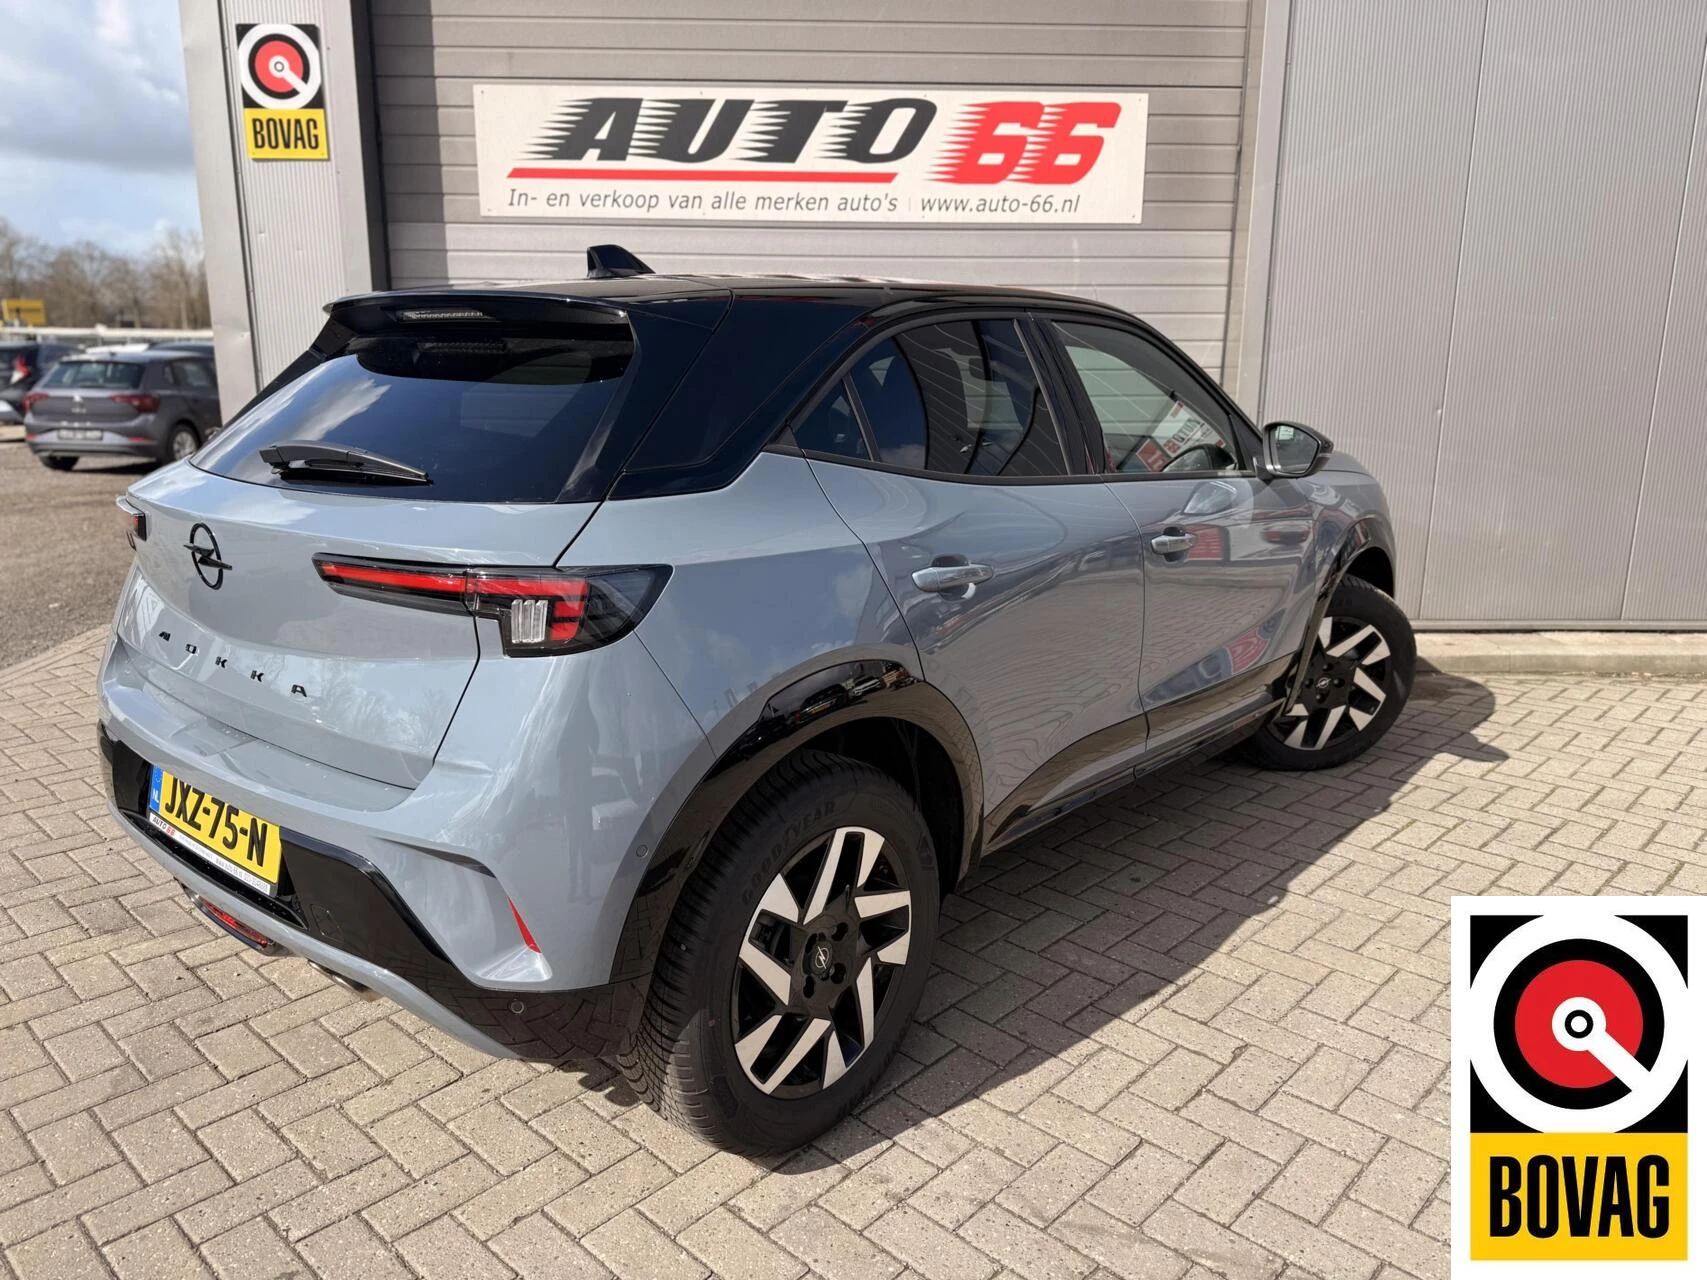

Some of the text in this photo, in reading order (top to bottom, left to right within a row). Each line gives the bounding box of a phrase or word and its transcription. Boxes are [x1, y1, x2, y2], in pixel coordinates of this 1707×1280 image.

[252, 118, 320, 150] BOVAG
[512, 97, 1122, 185] AUTO 66
[508, 188, 1080, 213] In- en verkoop van alle merken auto's www.auto-66.nl
[159, 631, 307, 698] MOKKA
[151, 788, 160, 803] NL
[151, 816, 167, 831] AUTO
[165, 776, 268, 867] JXZ-75-N
